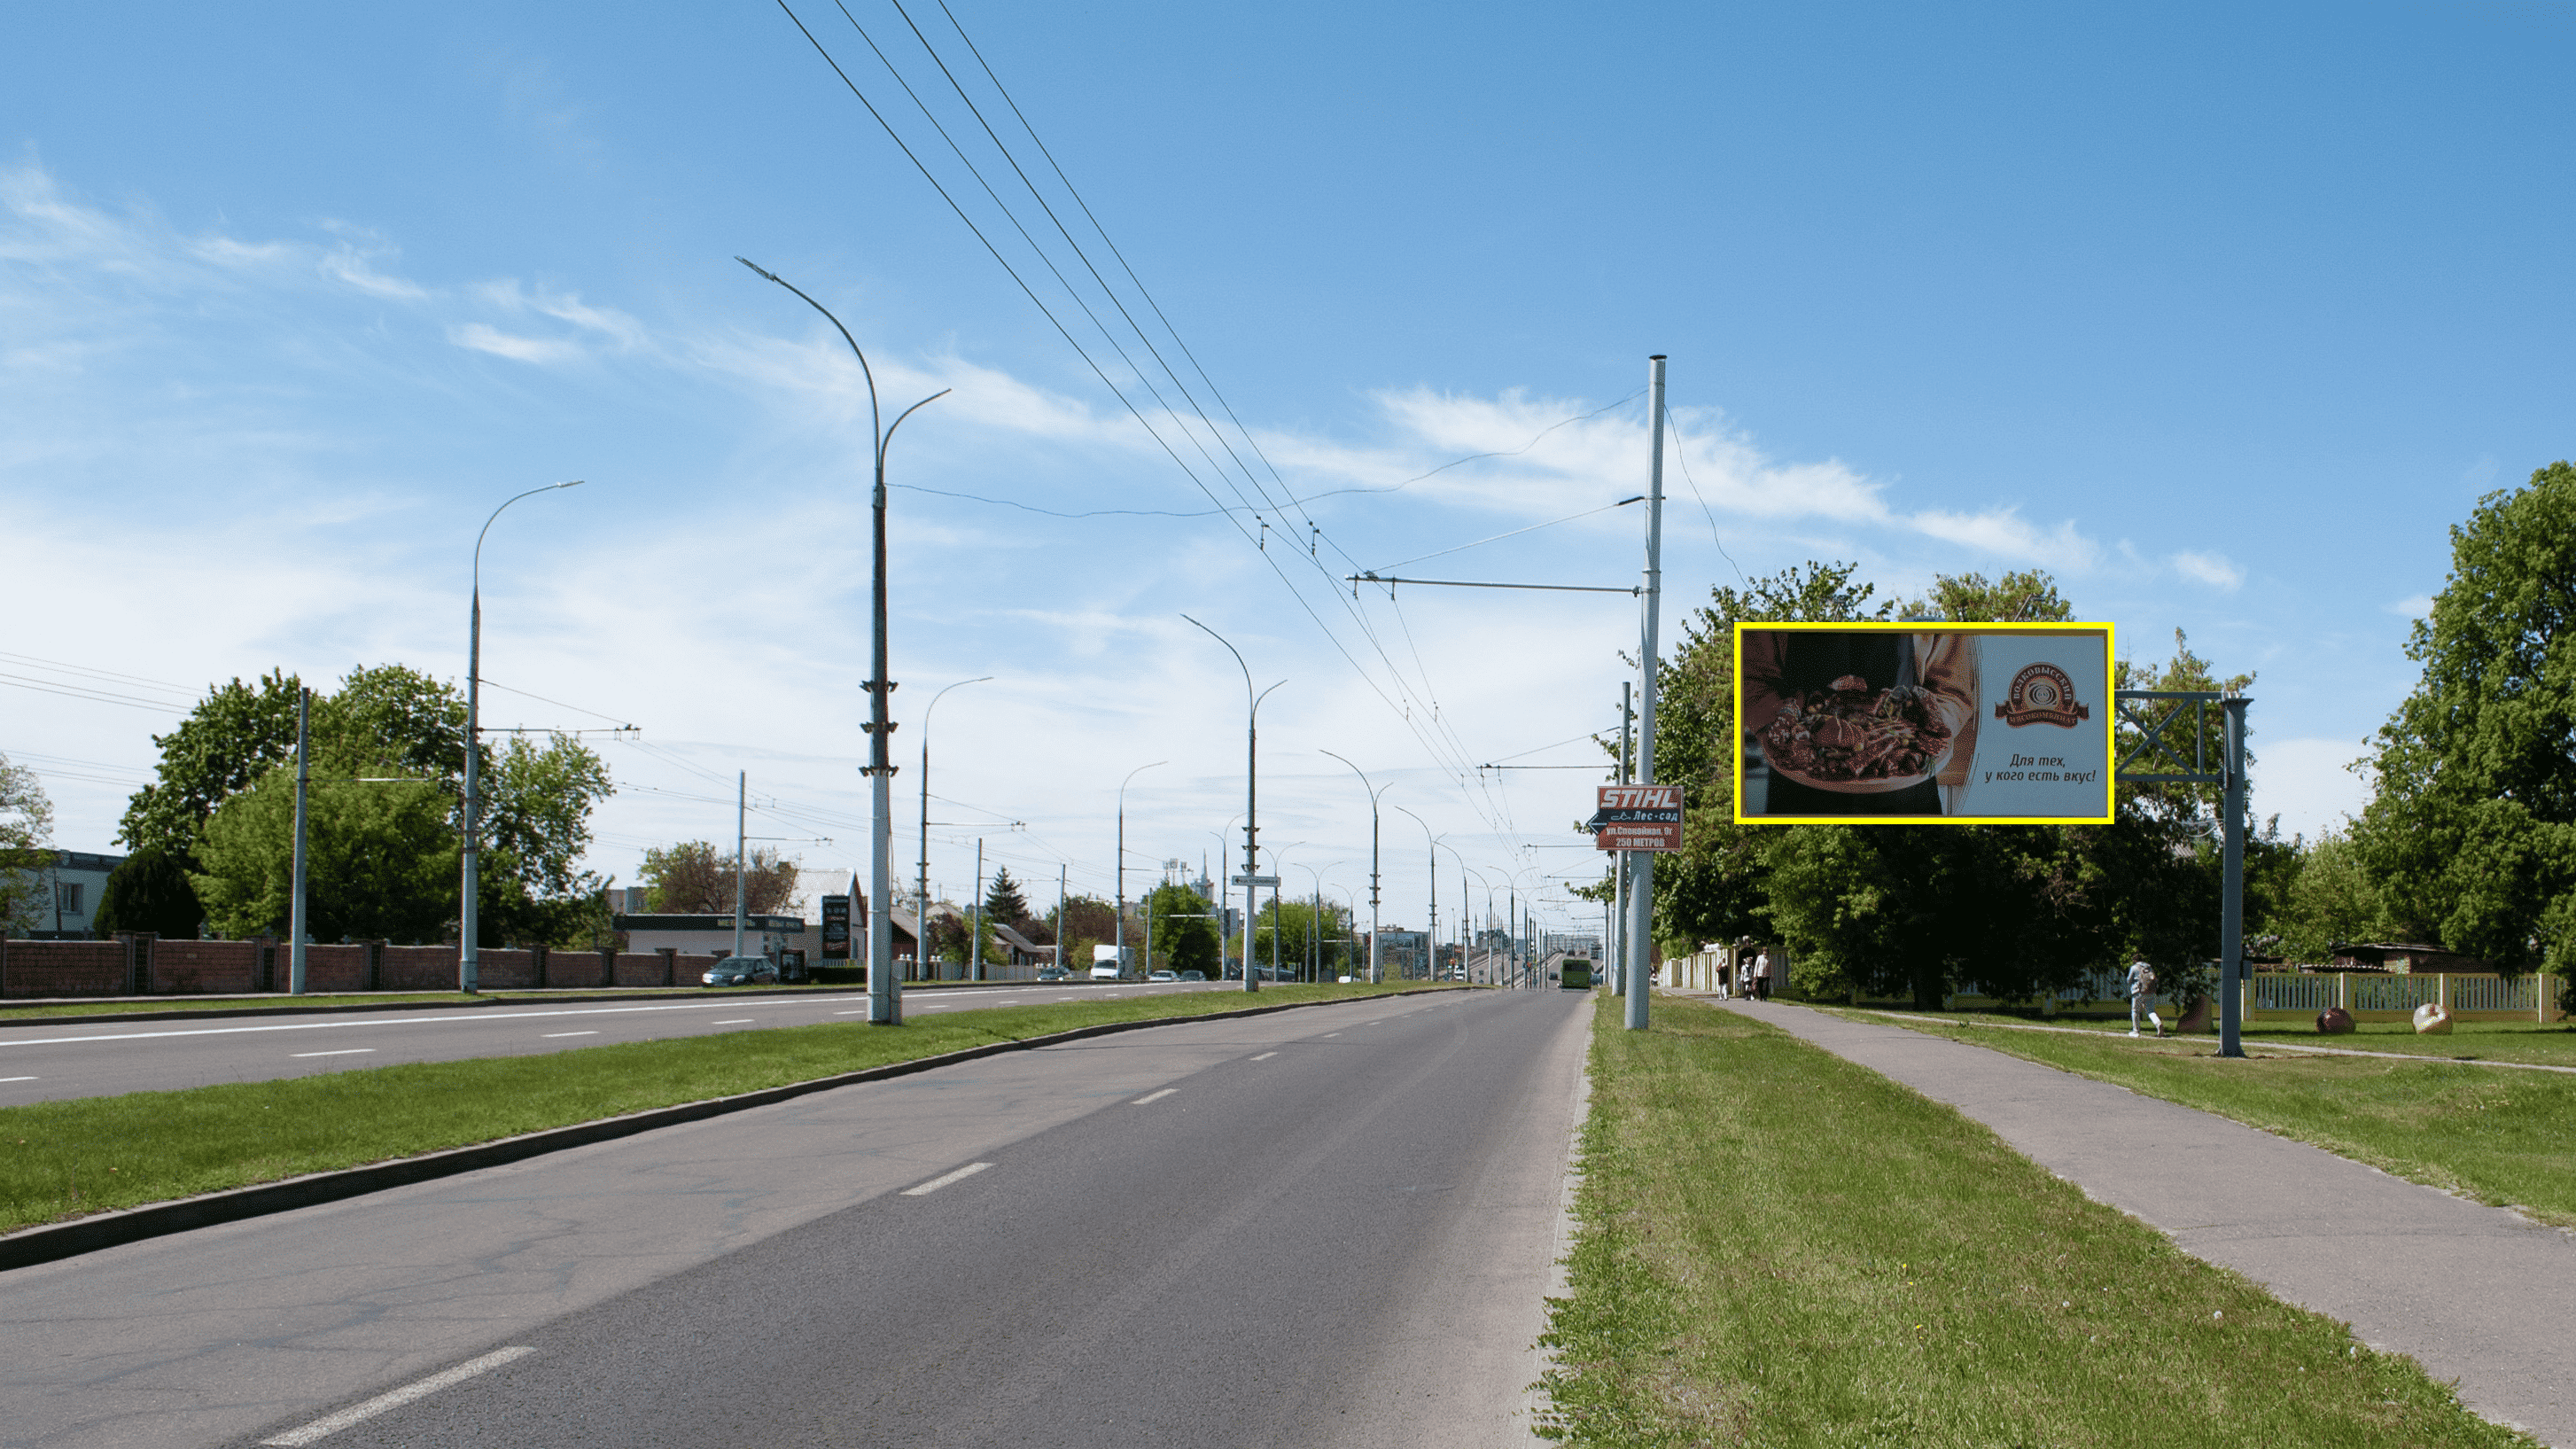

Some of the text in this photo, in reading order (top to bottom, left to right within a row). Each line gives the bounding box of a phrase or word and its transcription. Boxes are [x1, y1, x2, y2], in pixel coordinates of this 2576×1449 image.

[2009, 753, 2066, 768] Для тех,
[1984, 769, 2097, 785] у кого есть вкус!
[1599, 790, 1678, 808] STIHL
[1616, 837, 1665, 847] 250 МЕТРОВ
